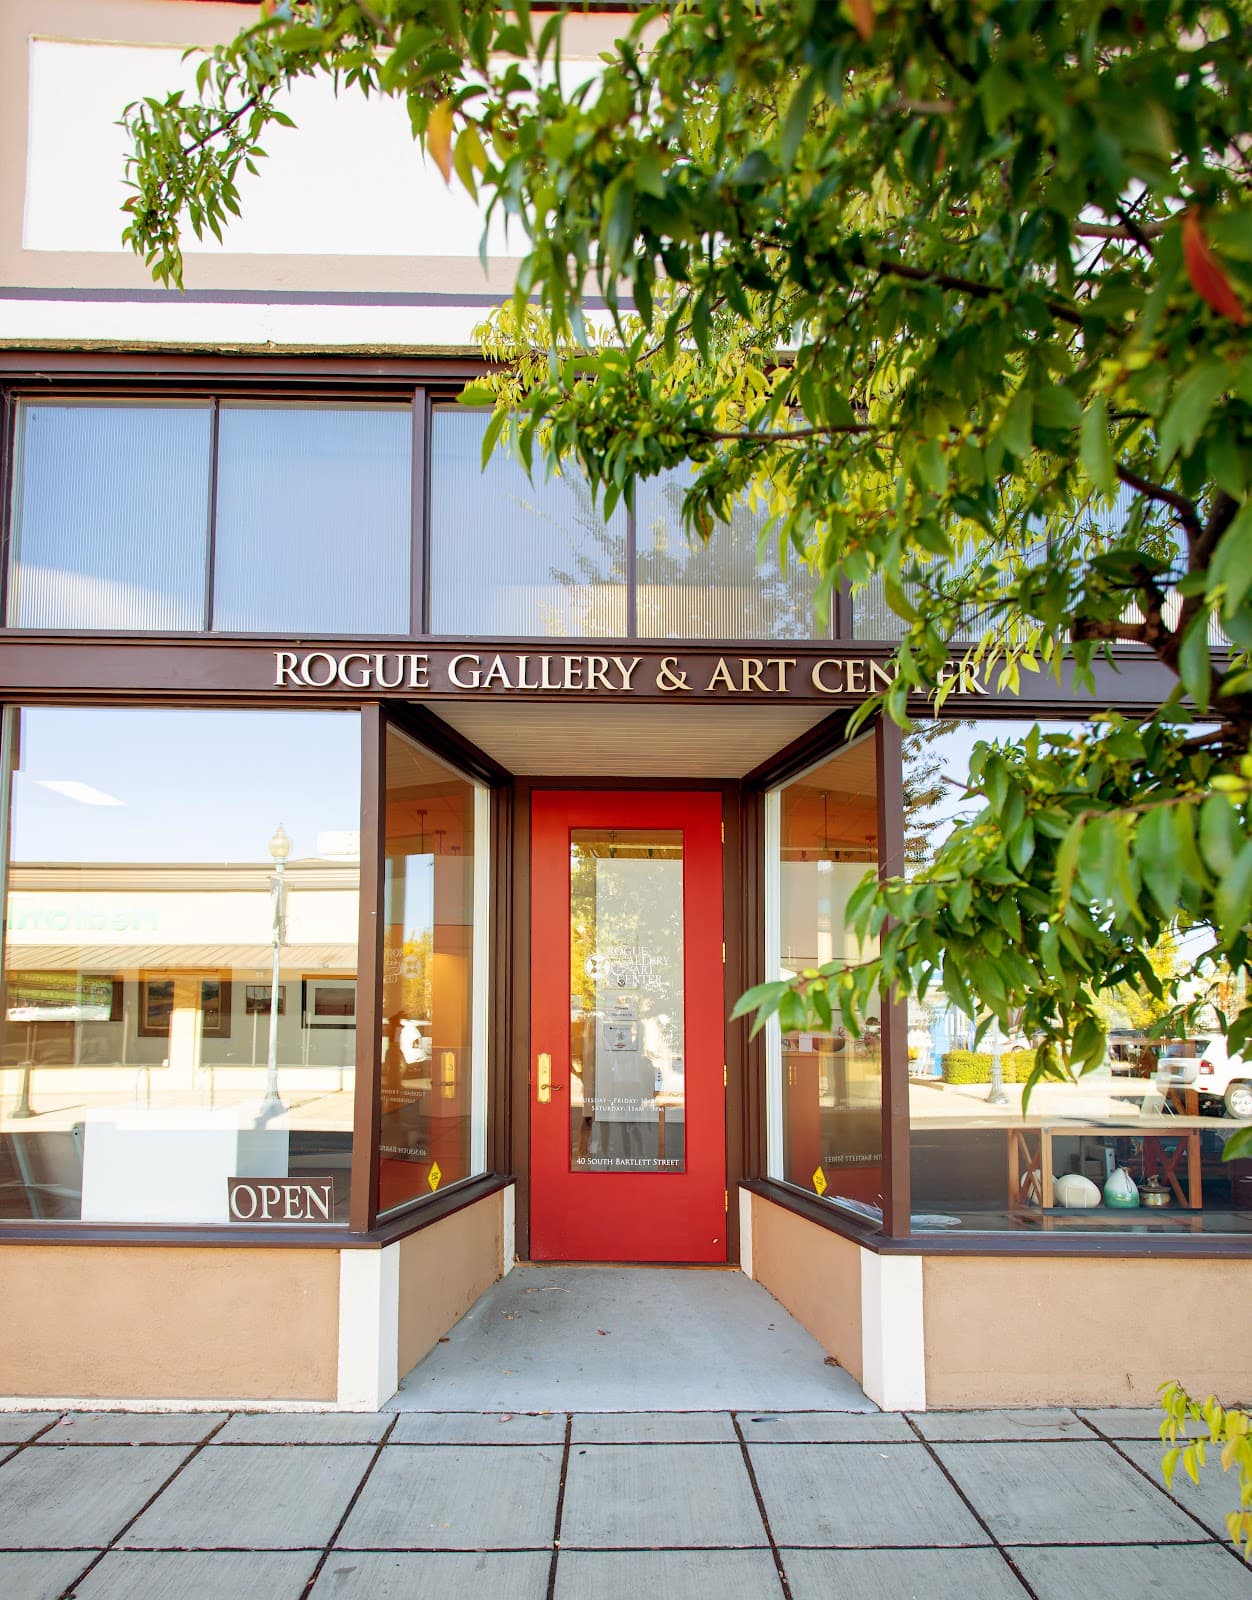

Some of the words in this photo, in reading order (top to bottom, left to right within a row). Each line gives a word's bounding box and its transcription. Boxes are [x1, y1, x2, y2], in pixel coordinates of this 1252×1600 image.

[273, 652, 430, 688] ROGUE
[448, 654, 643, 690] GALLERY
[655, 656, 694, 692] &
[704, 657, 797, 693] ART
[811, 659, 990, 695] CENER
[577, 1157, 586, 1165] 40
[587, 1157, 613, 1166] SOUTH
[615, 1157, 651, 1166] BARTLETT
[653, 1158, 680, 1166] STREET
[230, 1184, 331, 1219] OPEN
